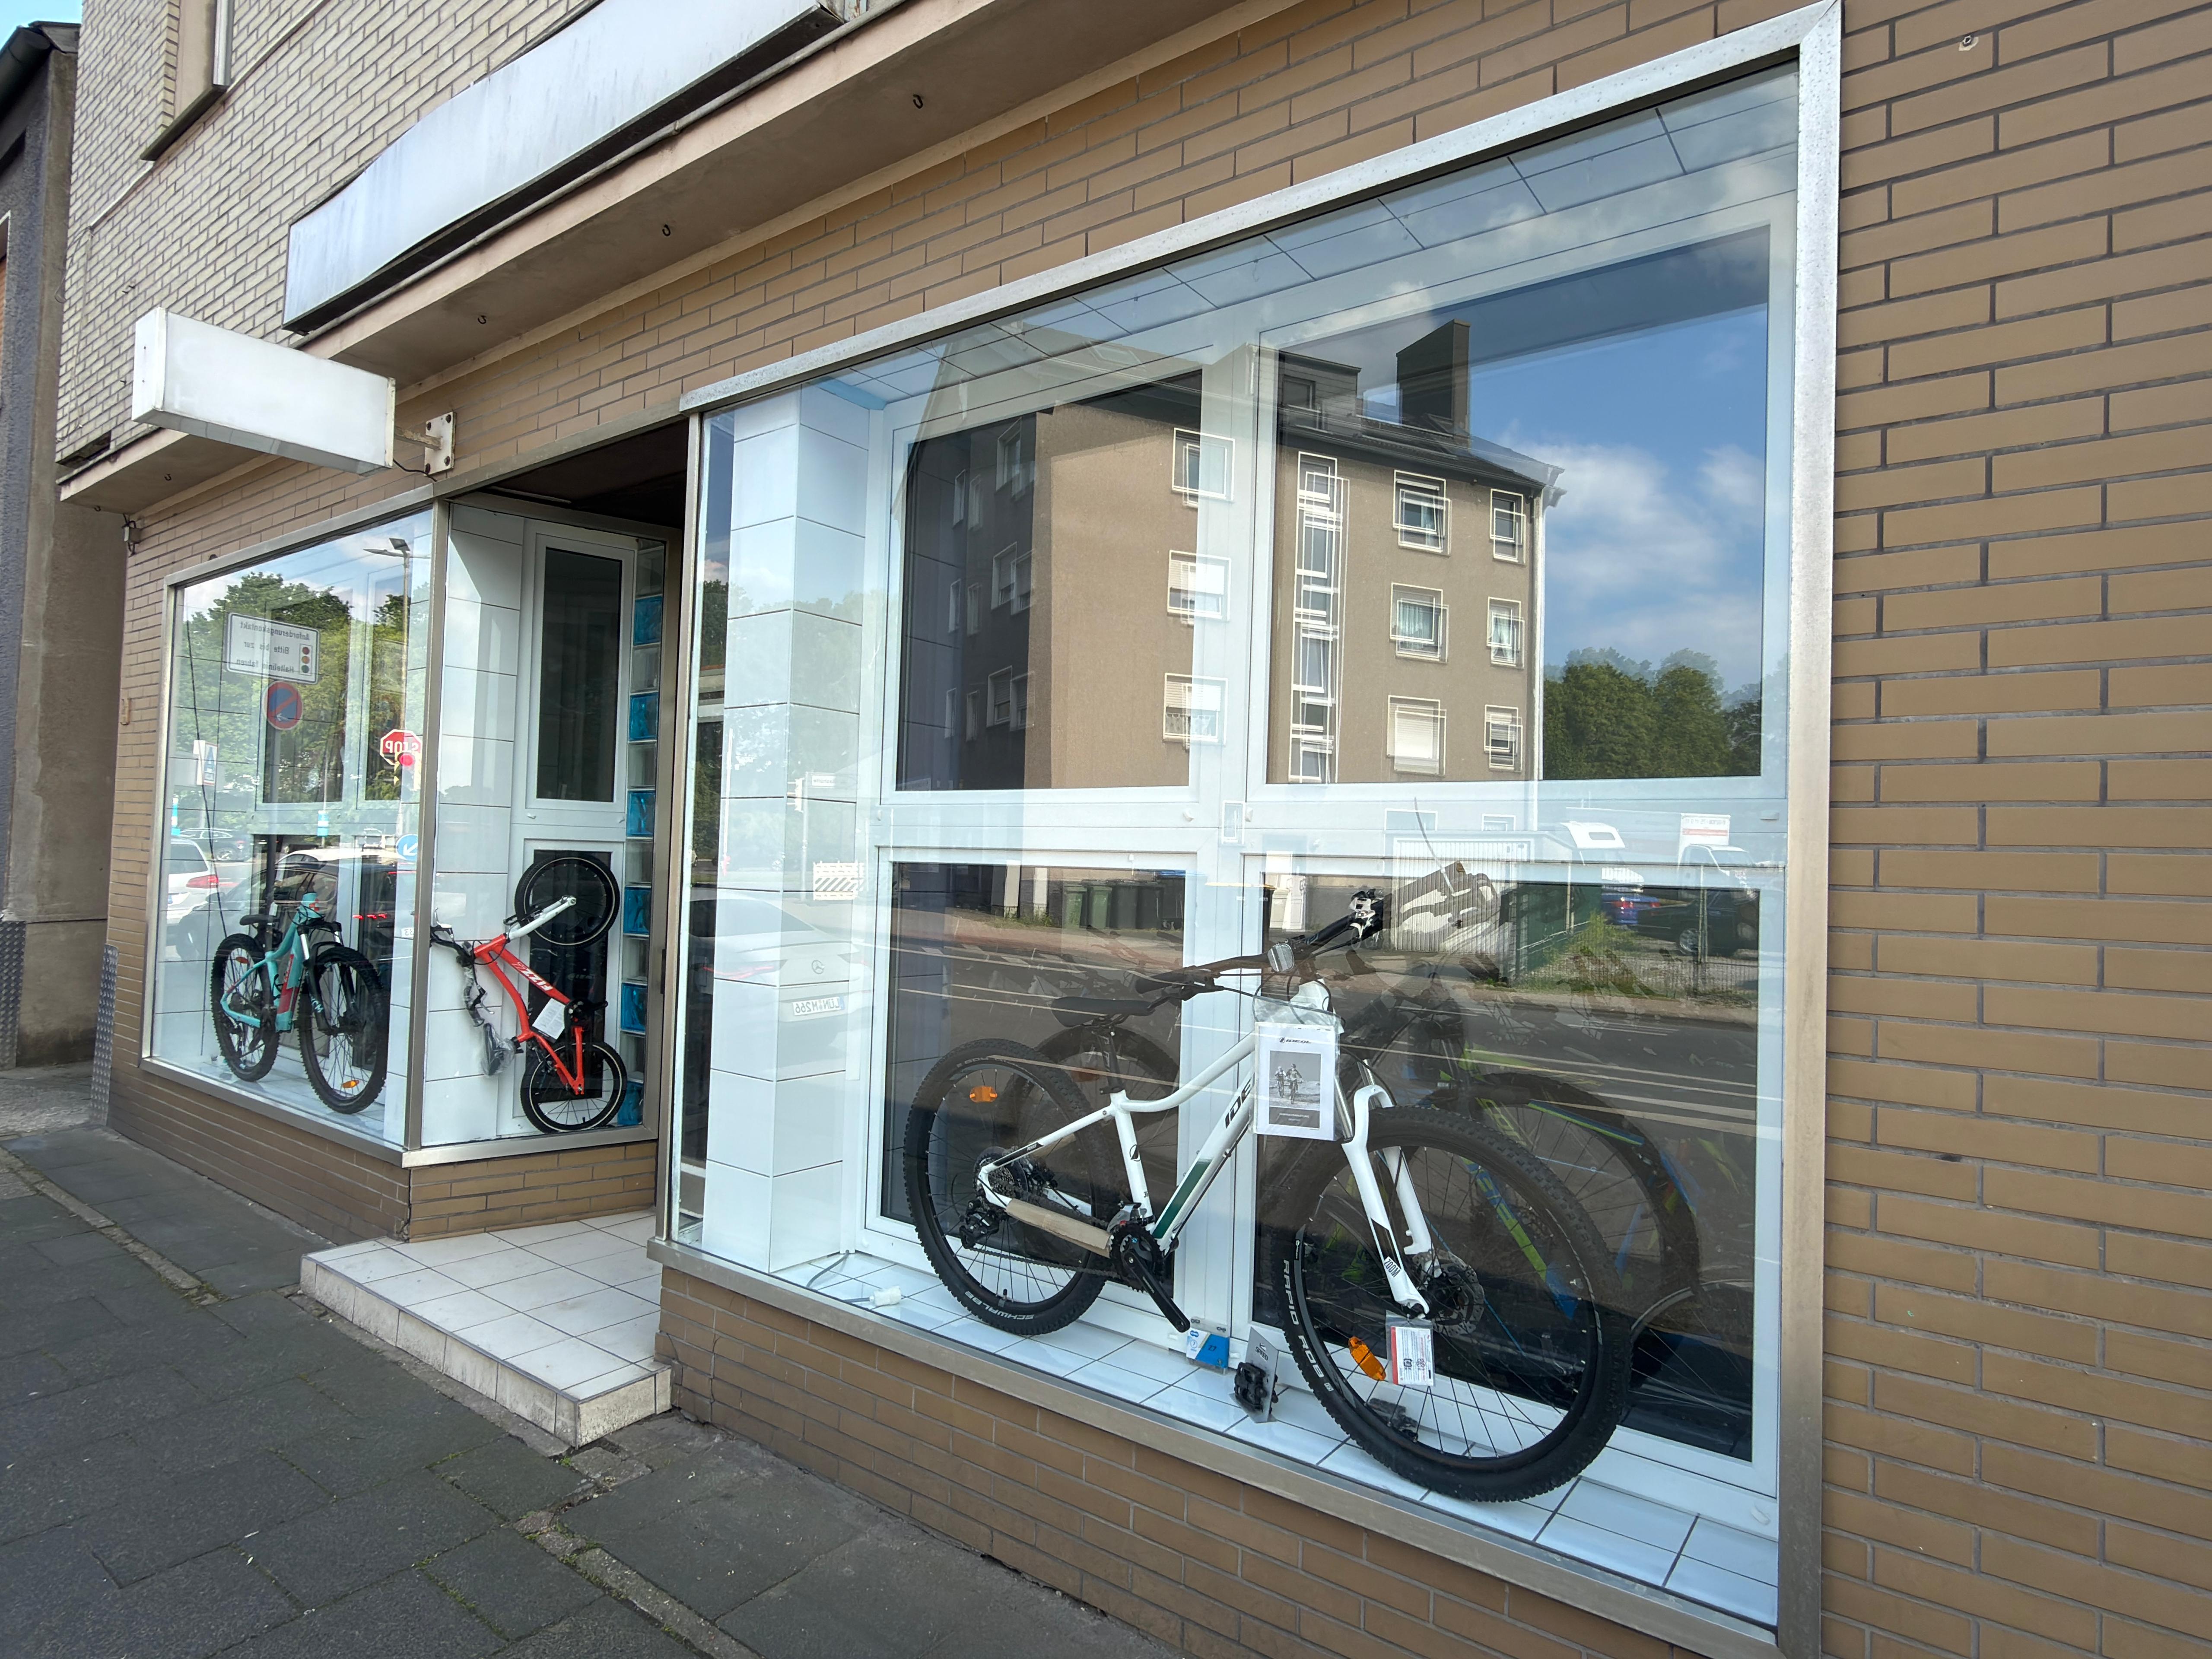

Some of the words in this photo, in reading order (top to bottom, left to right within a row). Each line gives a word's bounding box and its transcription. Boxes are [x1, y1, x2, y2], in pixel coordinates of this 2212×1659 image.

[1225, 1072, 1255, 1129] IDE
[1384, 1259, 1401, 1278] ZOOM
[964, 1290, 1035, 1320] SCHWALBE
[1283, 1259, 1299, 1325] RAPID
[1298, 1335, 1325, 1378] ROB
[1255, 1346, 1268, 1361] SPEED
